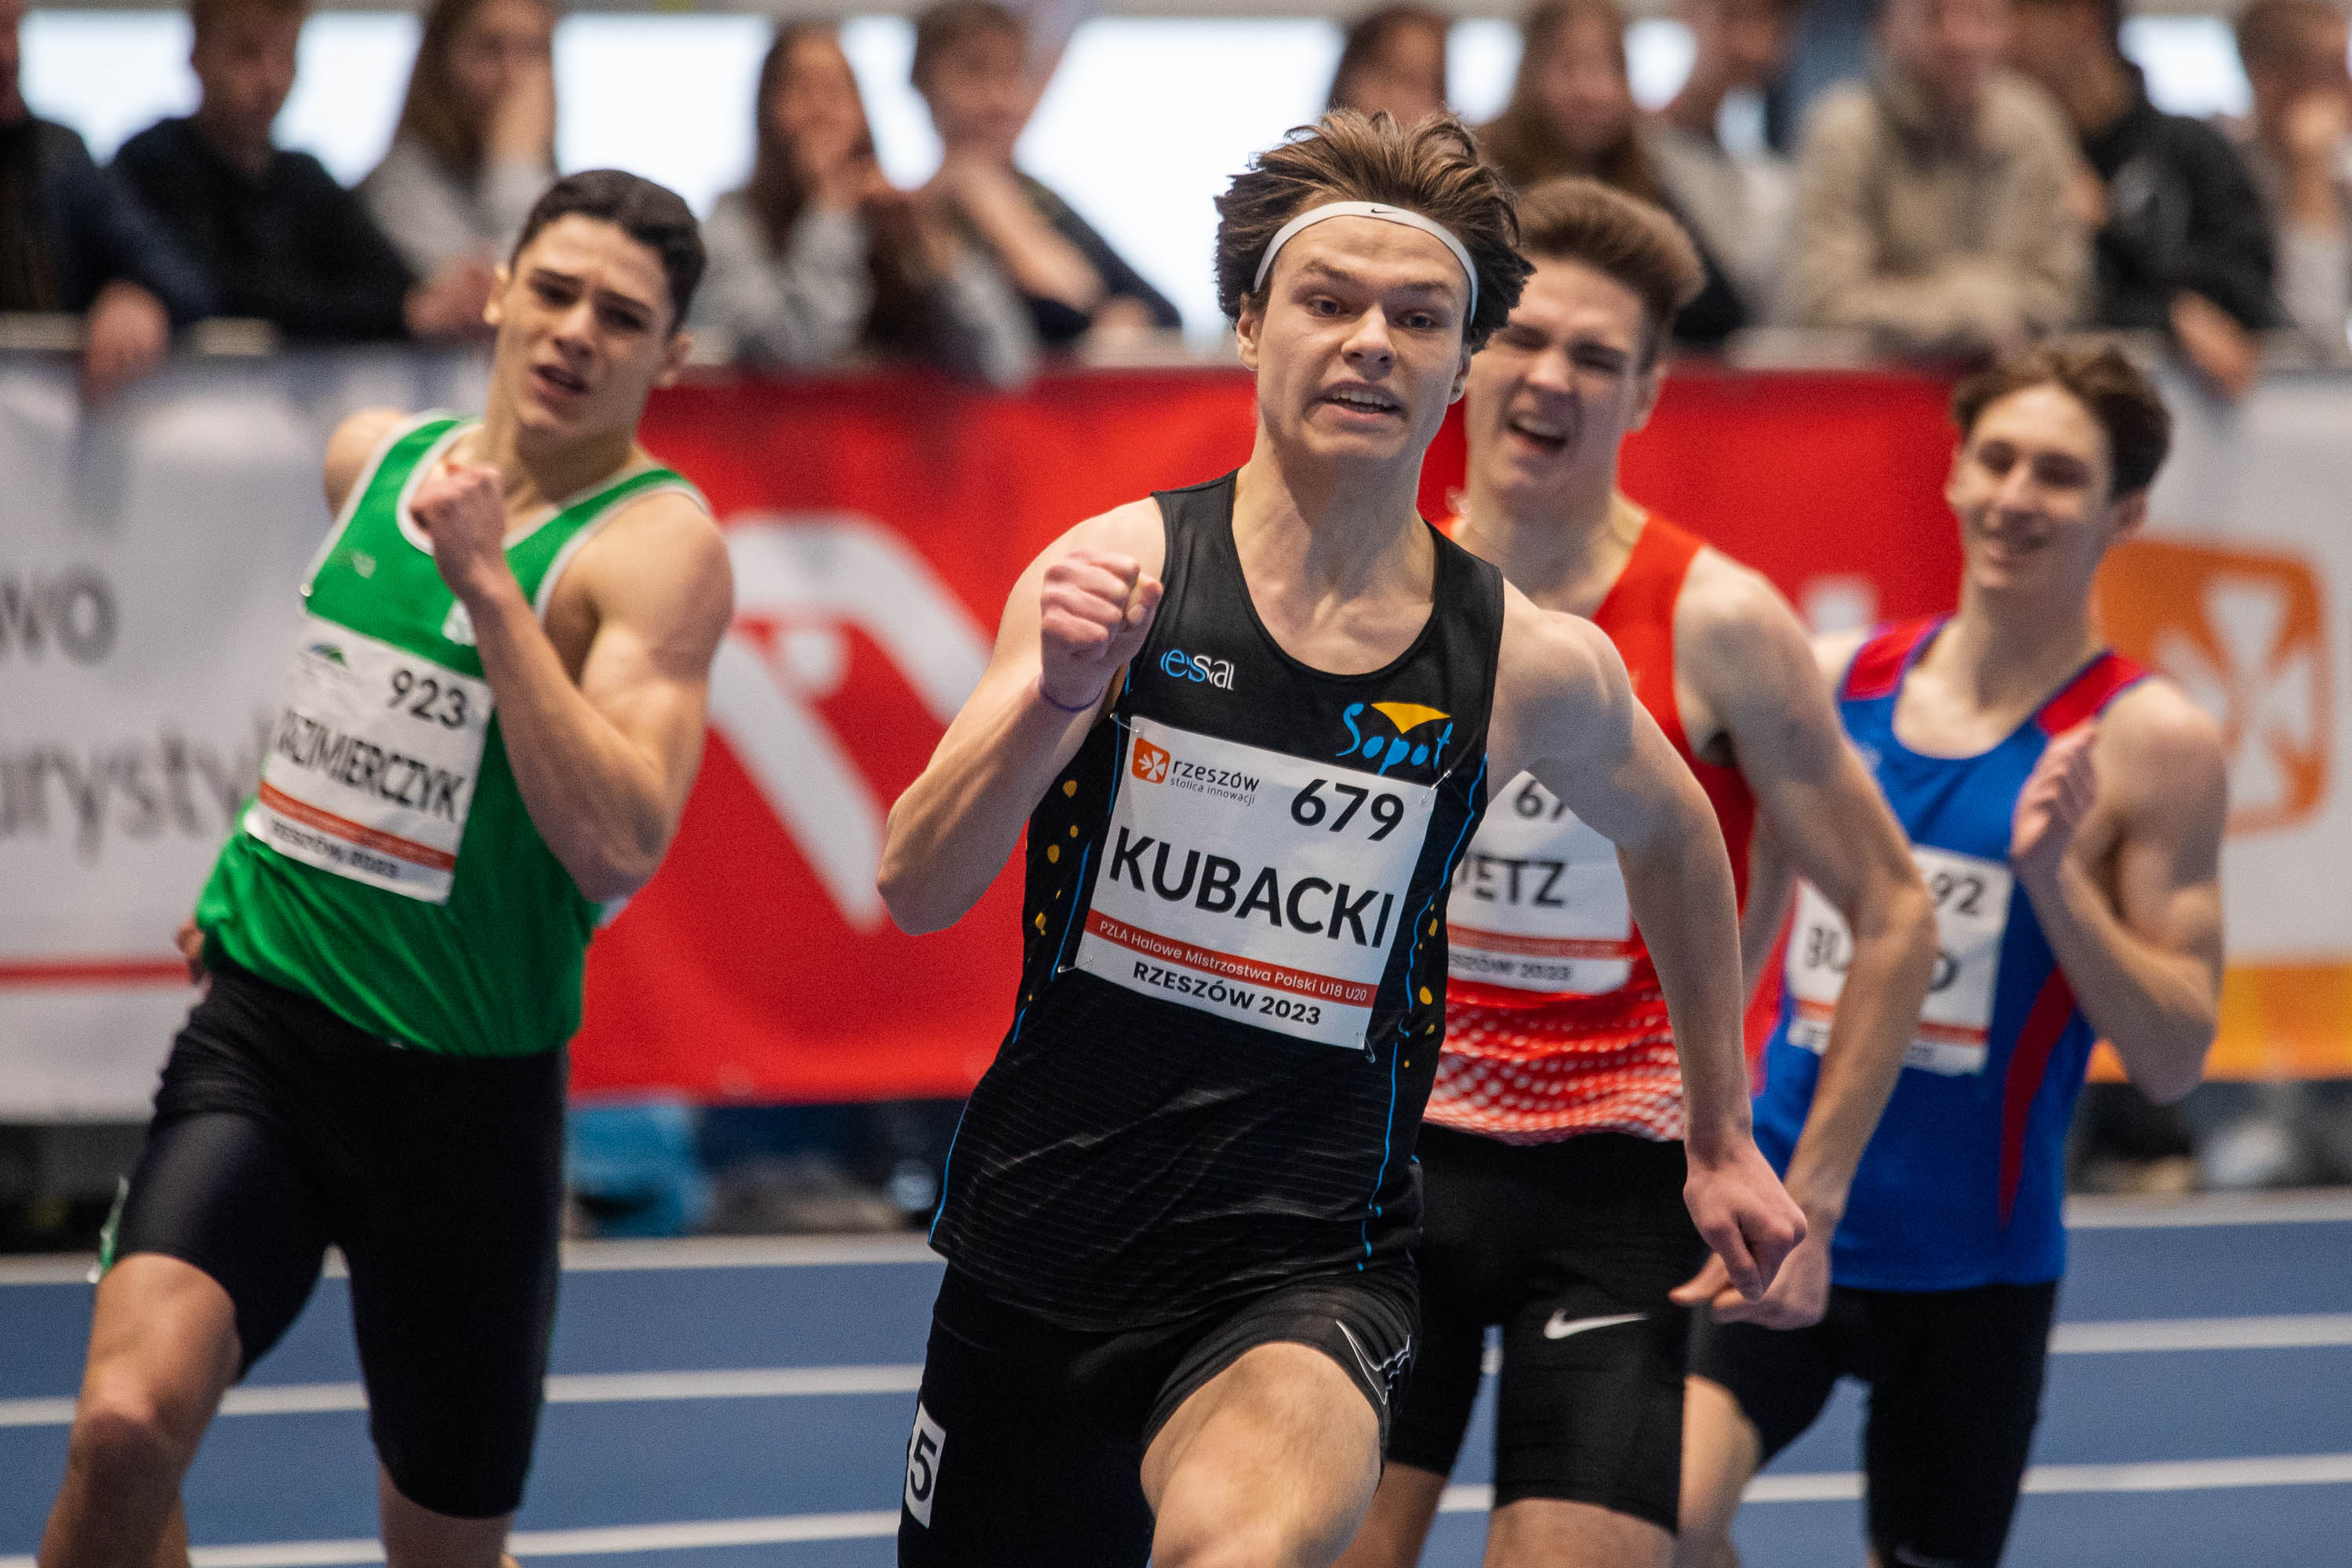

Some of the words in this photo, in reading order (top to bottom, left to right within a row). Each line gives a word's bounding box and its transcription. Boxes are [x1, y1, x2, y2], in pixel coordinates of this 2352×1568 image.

[389, 668, 469, 731] 923
[1335, 702, 1454, 776] Sopot
[1170, 778, 1204, 793] stolica
[1206, 785, 1255, 807] innowacji
[1172, 759, 1260, 793] rzeszów
[1290, 778, 1405, 842] 679
[1109, 826, 1395, 949] KUBACKI
[1099, 921, 1129, 942] PZLA
[1131, 933, 1183, 960] Halowe
[1185, 952, 1272, 983] Mistrzostwa
[1274, 972, 1317, 993] Polski
[1319, 981, 1342, 998] U18
[1345, 984, 1368, 1003] U20
[1133, 961, 1256, 1011] RZESZÓW
[1258, 996, 1322, 1026] 2023
[910, 1428, 938, 1503] 5
